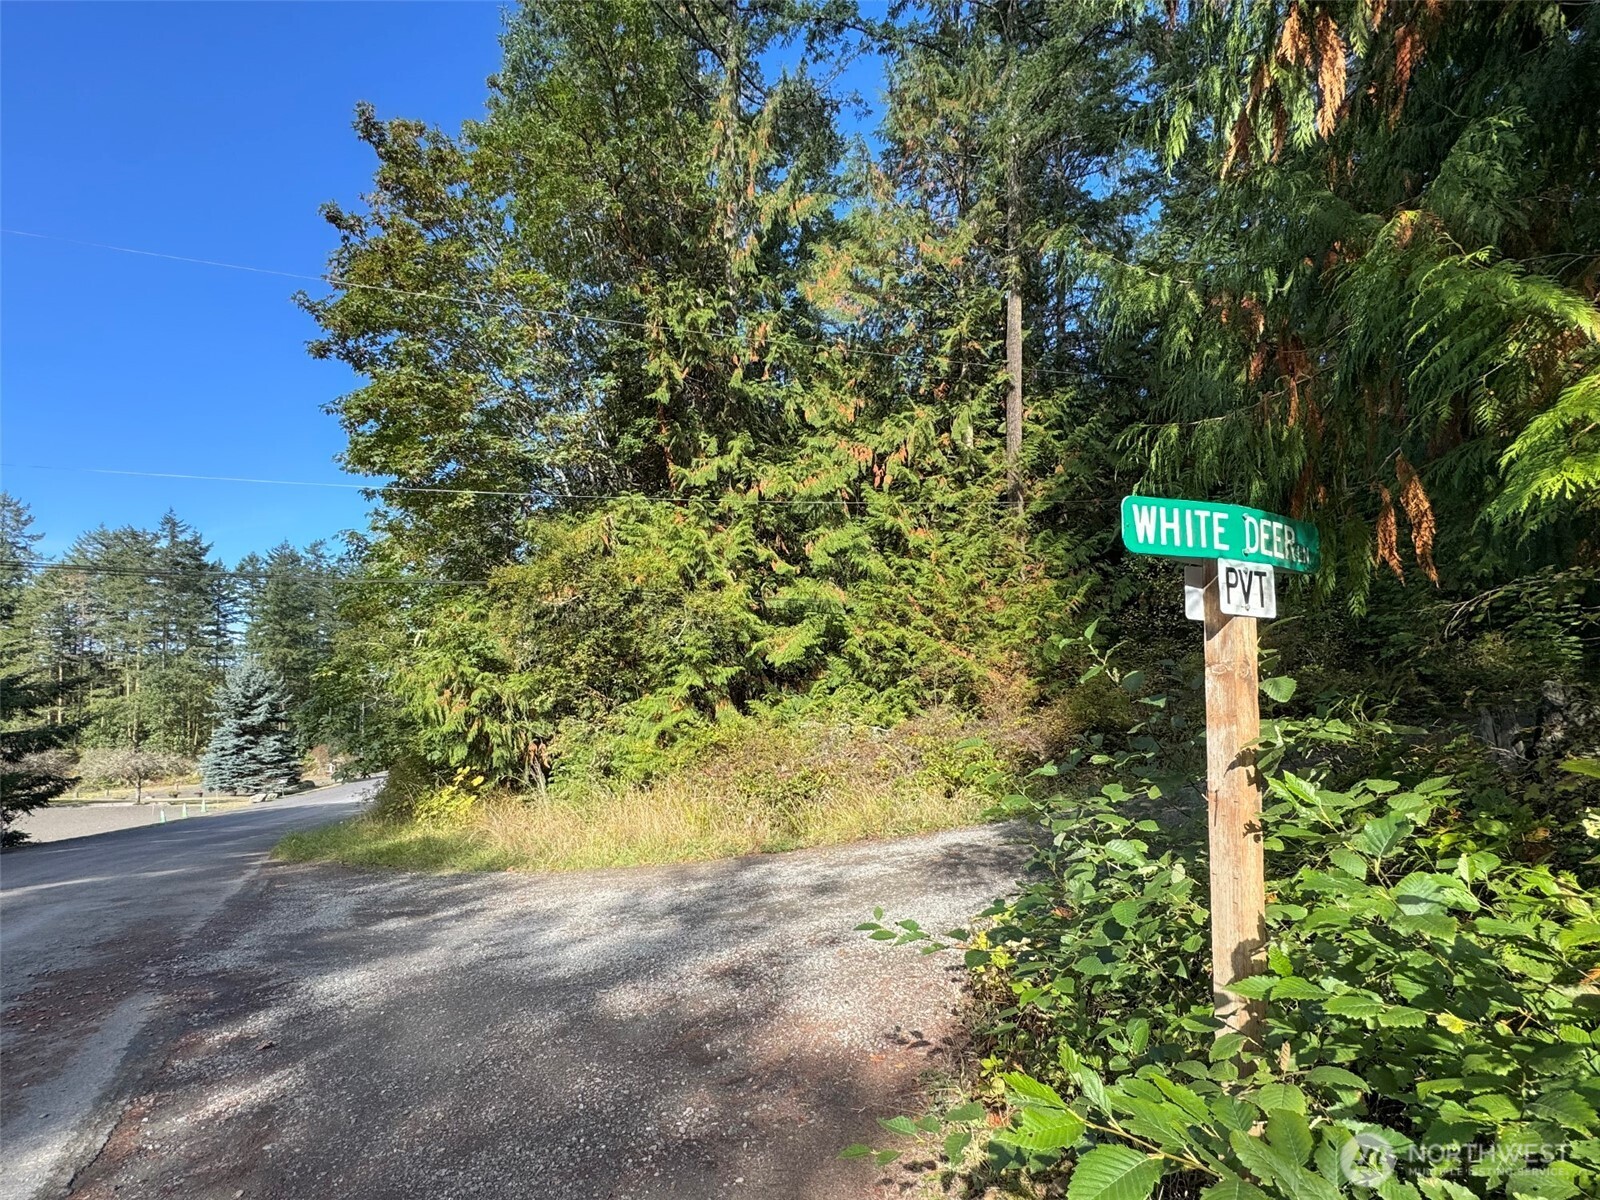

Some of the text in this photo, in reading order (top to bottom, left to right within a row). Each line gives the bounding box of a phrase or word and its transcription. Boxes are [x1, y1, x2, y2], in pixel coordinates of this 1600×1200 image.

[1132, 503, 1230, 551] WHITE
[1243, 514, 1296, 562] DEER
[1226, 567, 1267, 607] PVT
